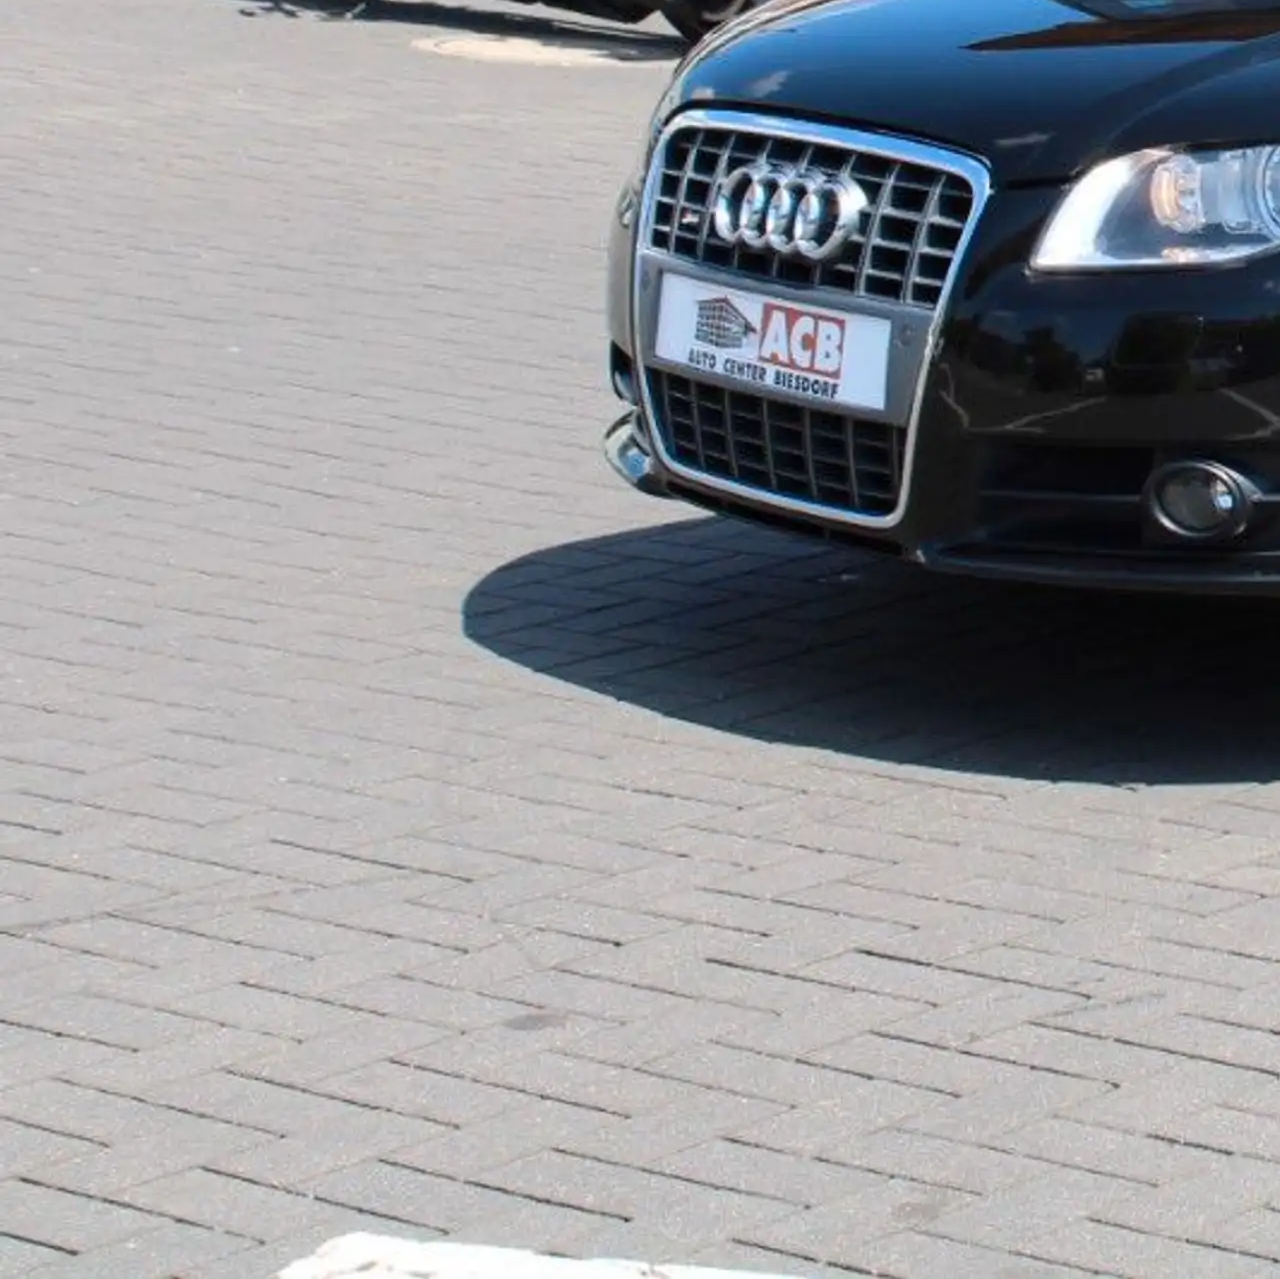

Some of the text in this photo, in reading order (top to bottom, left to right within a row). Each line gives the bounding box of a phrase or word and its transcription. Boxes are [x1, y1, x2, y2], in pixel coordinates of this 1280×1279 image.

[760, 309, 841, 375] ACB
[688, 347, 839, 400] AUTO CENTER BIESDORF
